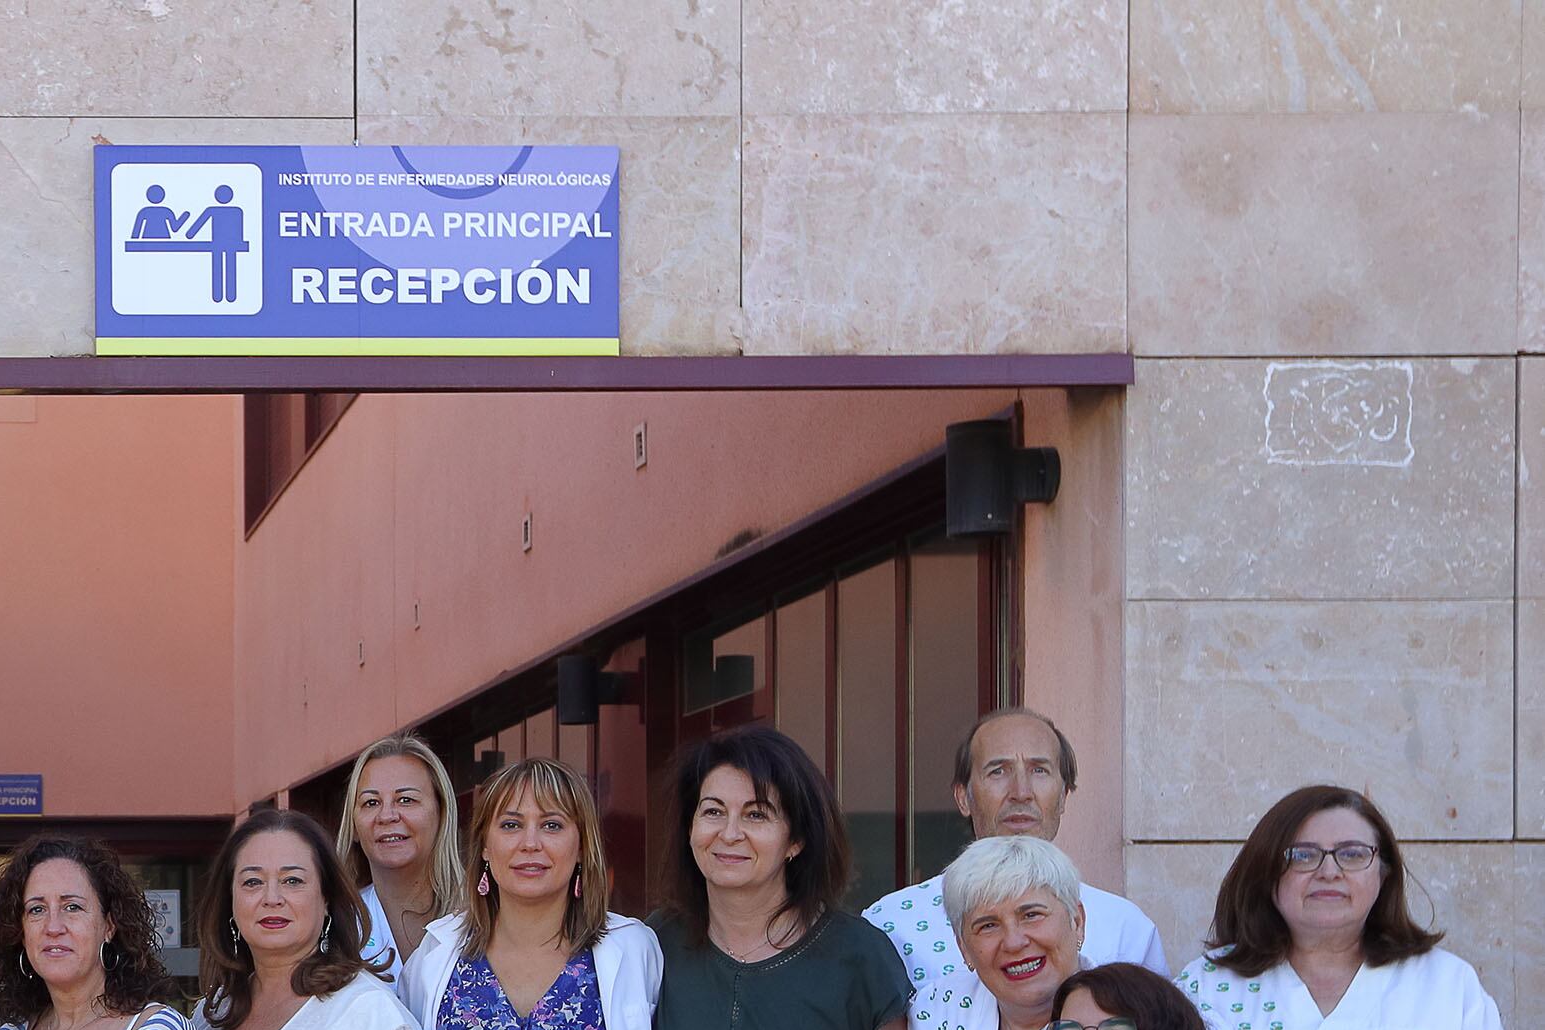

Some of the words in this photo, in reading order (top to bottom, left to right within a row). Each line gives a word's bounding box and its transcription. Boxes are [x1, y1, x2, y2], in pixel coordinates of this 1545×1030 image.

[278, 173, 352, 186] INSTITUTO
[355, 173, 375, 186] DE
[378, 173, 495, 186] ENFERMEDADES
[498, 171, 611, 187] NEUROLÓGICAS
[279, 212, 435, 238] ENTRADA
[443, 212, 612, 238] PRINCIPAL
[292, 259, 590, 304] RECEPCIÓN
